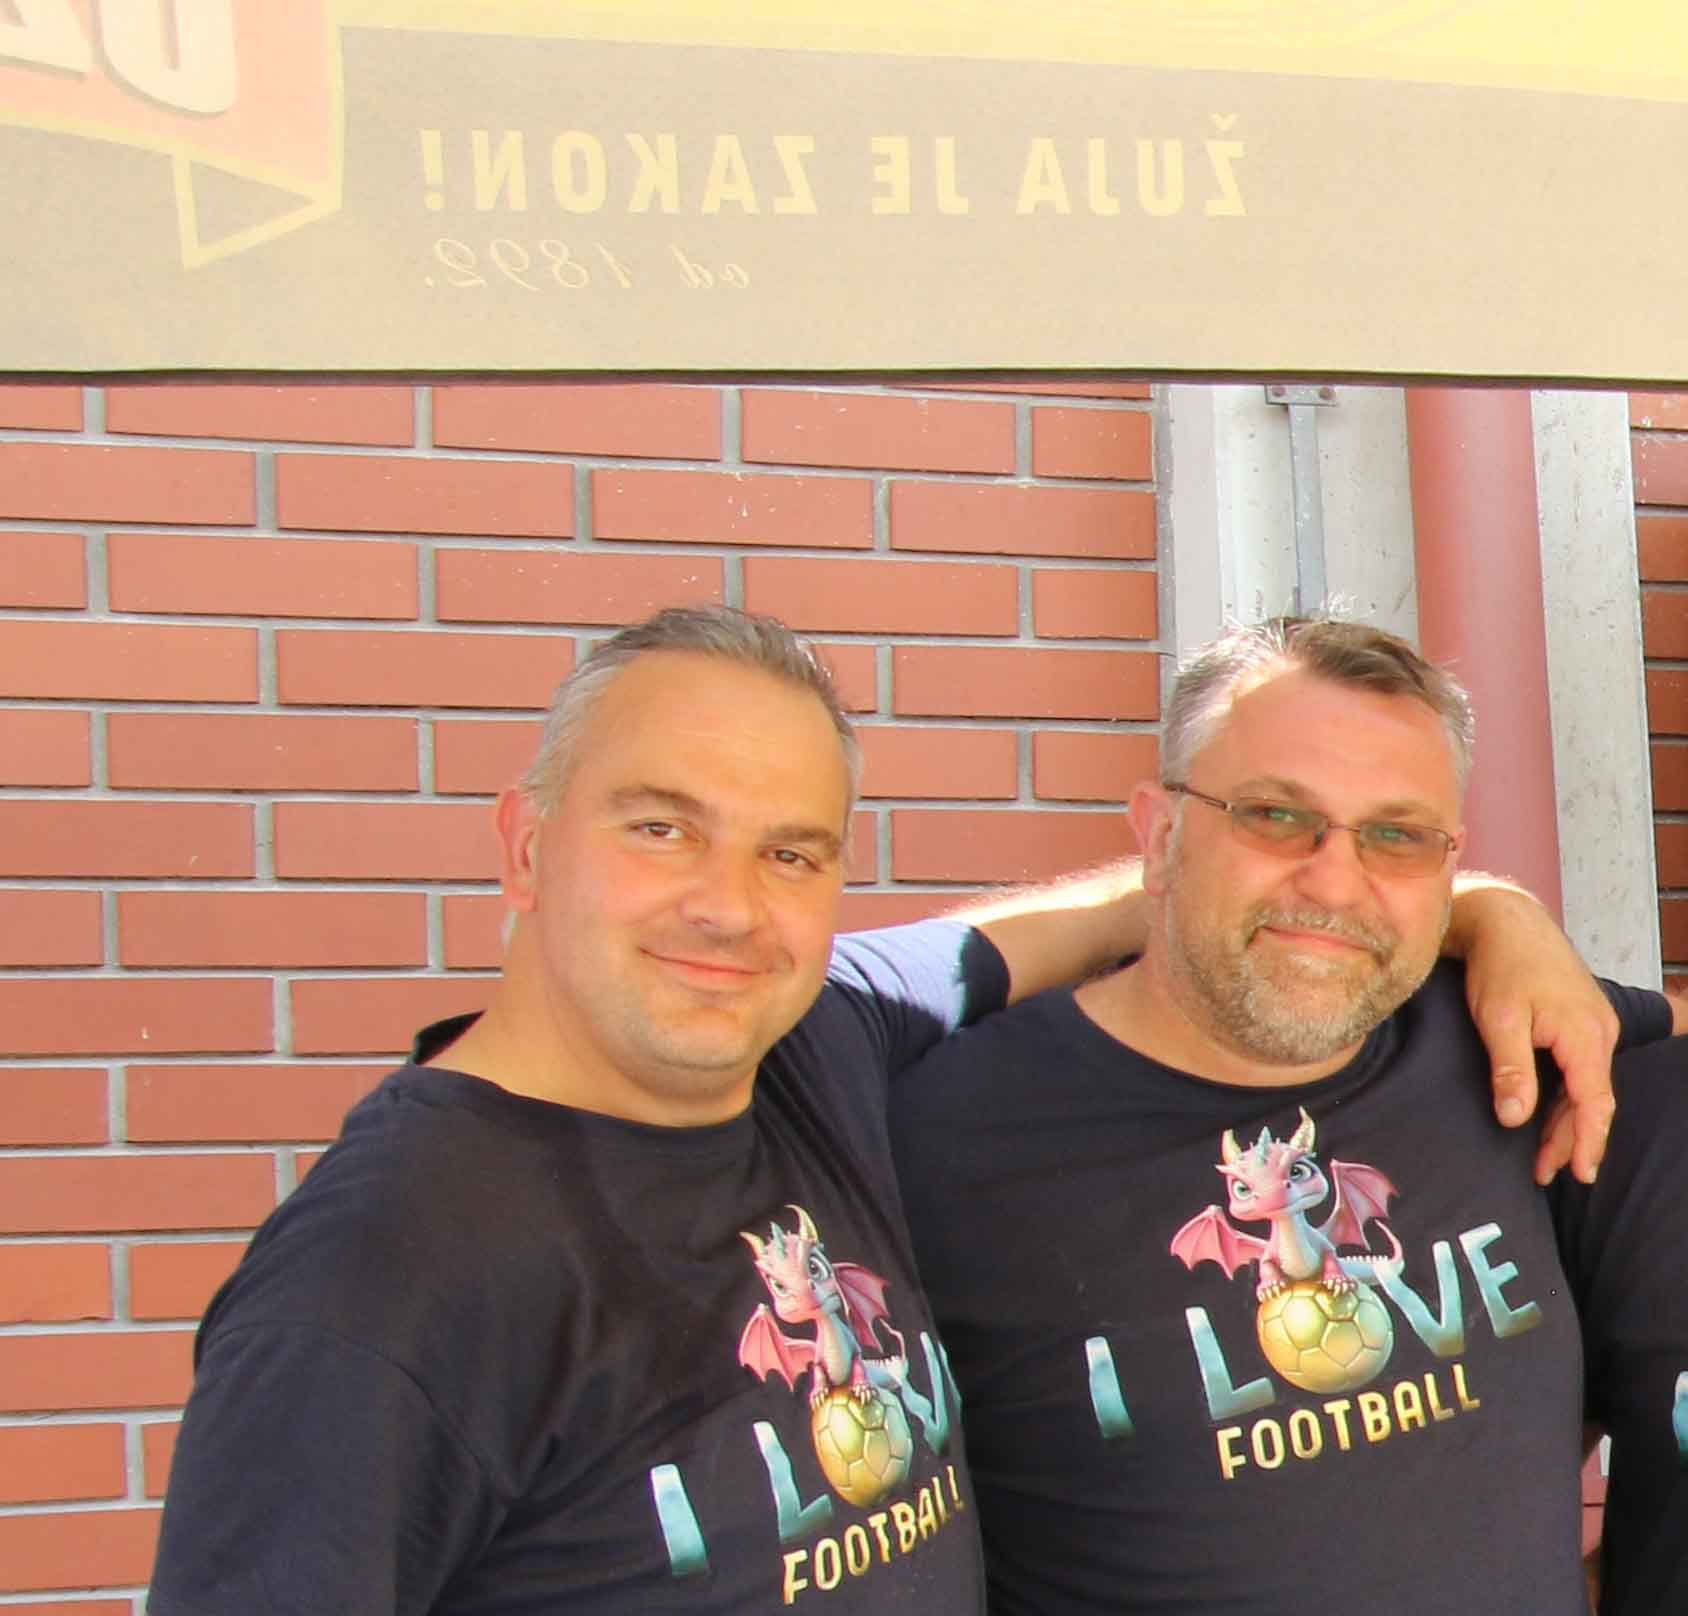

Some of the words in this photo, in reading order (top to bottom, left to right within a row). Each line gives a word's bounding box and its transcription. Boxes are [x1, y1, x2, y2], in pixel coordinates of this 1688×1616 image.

[1085, 1336, 1134, 1439] I
[1215, 1364, 1481, 1480] FOOTBALL
[650, 1463, 709, 1577] I
[782, 1465, 966, 1606] FOOTBALL
